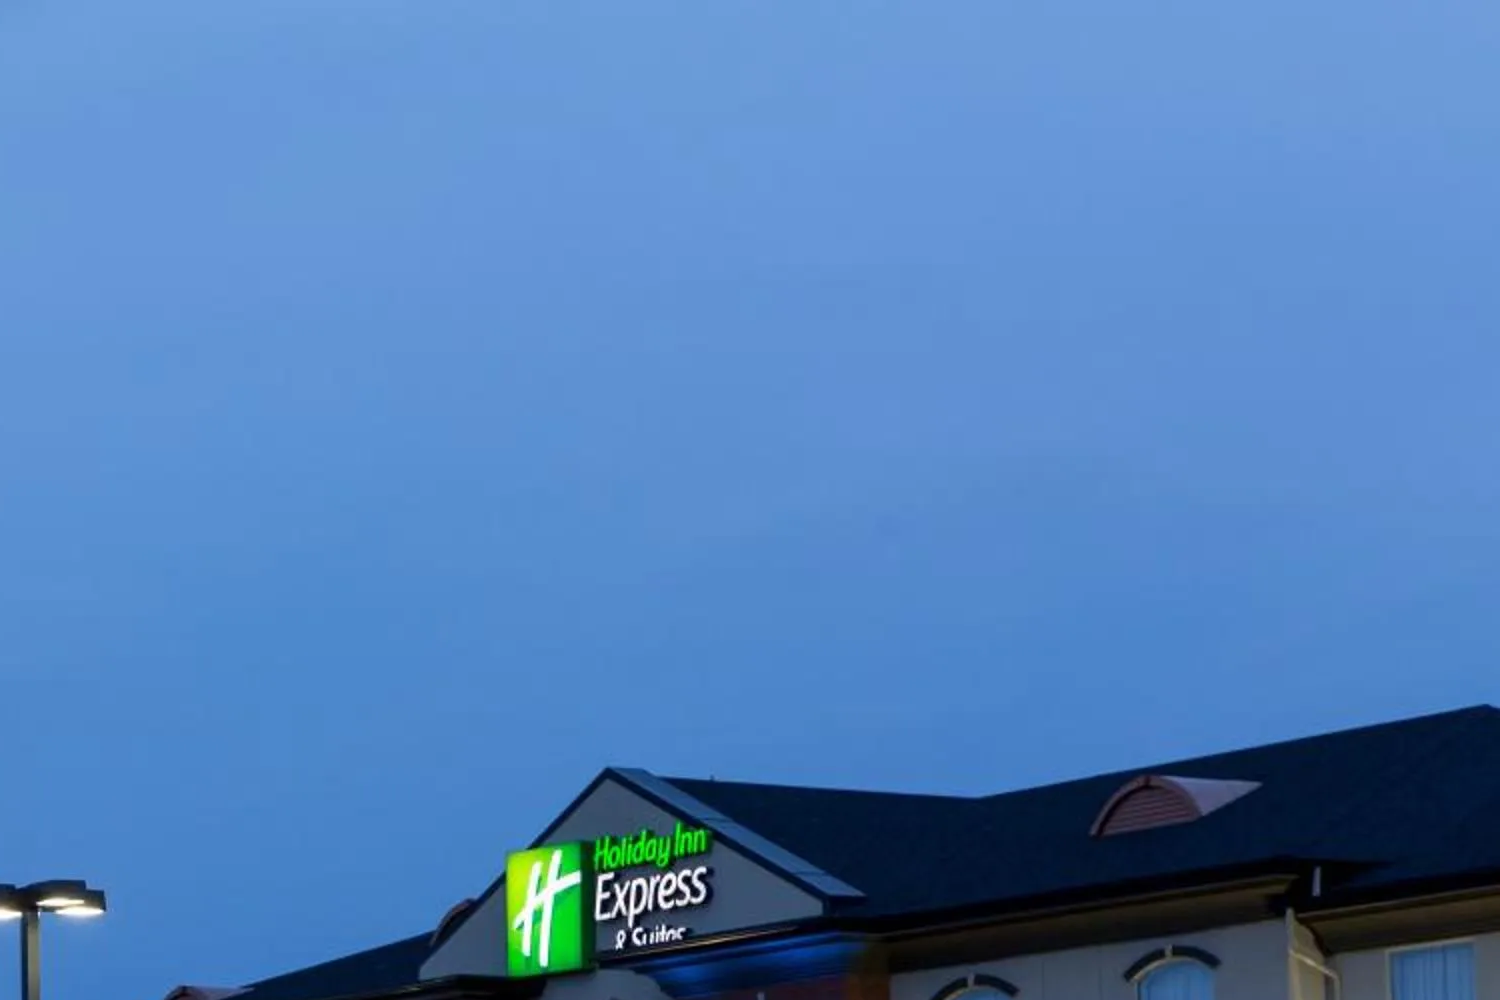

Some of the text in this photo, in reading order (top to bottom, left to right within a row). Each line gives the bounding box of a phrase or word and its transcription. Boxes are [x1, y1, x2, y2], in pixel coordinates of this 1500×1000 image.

[594, 821, 708, 871] Holiday Inn
[594, 866, 708, 928] Express
